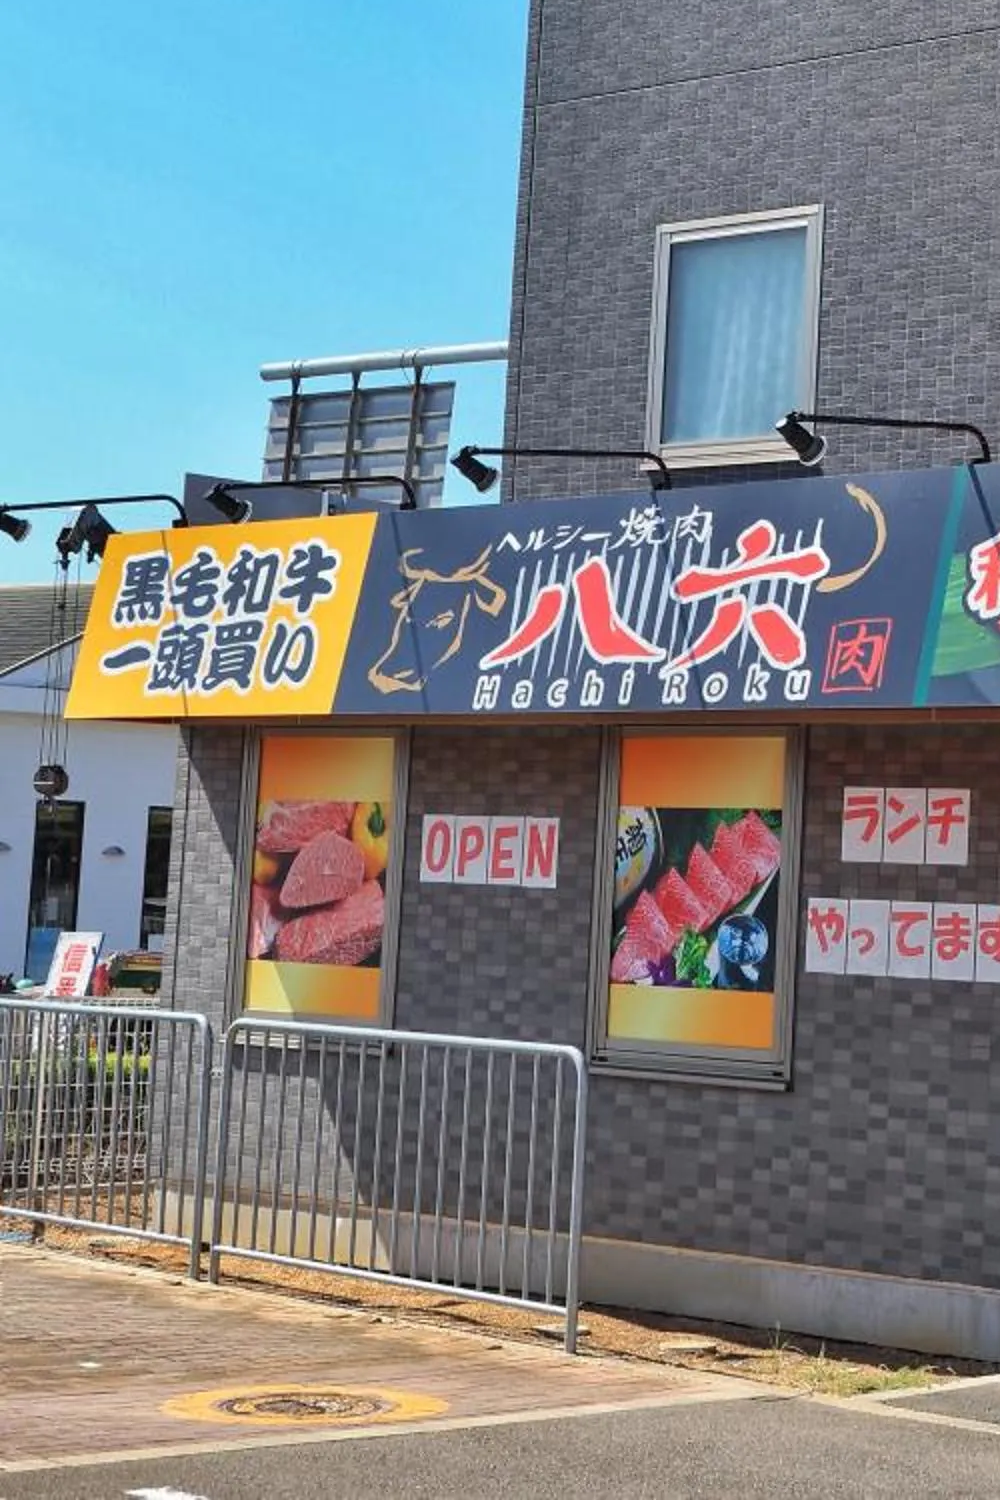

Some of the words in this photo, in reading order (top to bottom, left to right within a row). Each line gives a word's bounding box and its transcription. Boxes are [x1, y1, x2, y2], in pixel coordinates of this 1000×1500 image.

[496, 504, 713, 552] ヘルシー焼肉
[113, 538, 340, 630] 黒毛和牛
[480, 519, 831, 680] 八六
[99, 618, 319, 695] 一頭買い
[831, 623, 885, 685] 肉
[473, 668, 634, 710] Hachi
[660, 664, 811, 705] Roku
[425, 819, 559, 879] OPEN
[844, 793, 968, 846] ランチ
